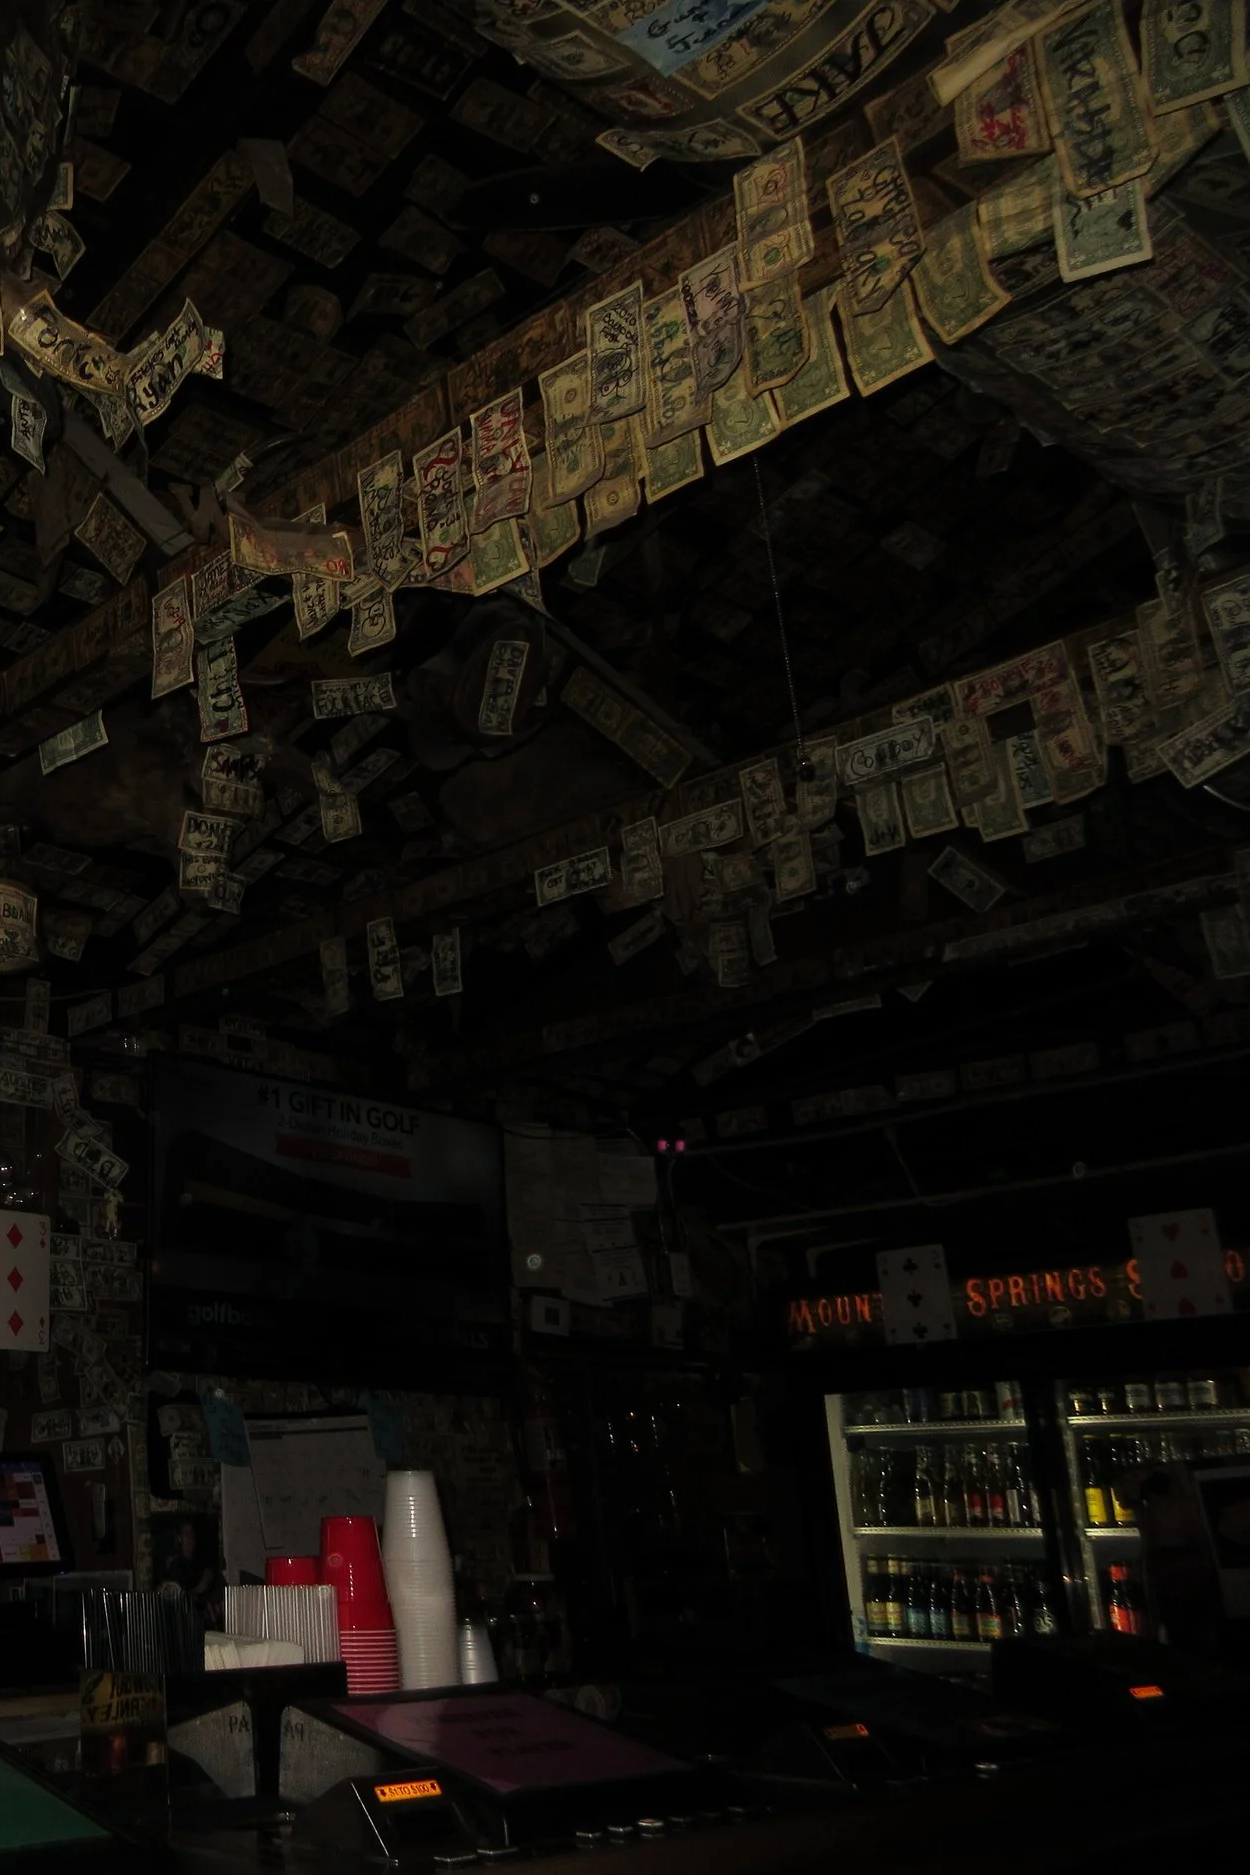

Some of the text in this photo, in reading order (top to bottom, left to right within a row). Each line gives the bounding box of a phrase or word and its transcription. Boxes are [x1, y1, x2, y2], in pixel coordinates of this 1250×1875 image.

[258, 1085, 419, 1135] #1 GIFT IN GOLF
[329, 1126, 368, 1146] Holiday
[965, 1266, 1106, 1319] SPRINGS
[399, 1786, 411, 1796] TO
